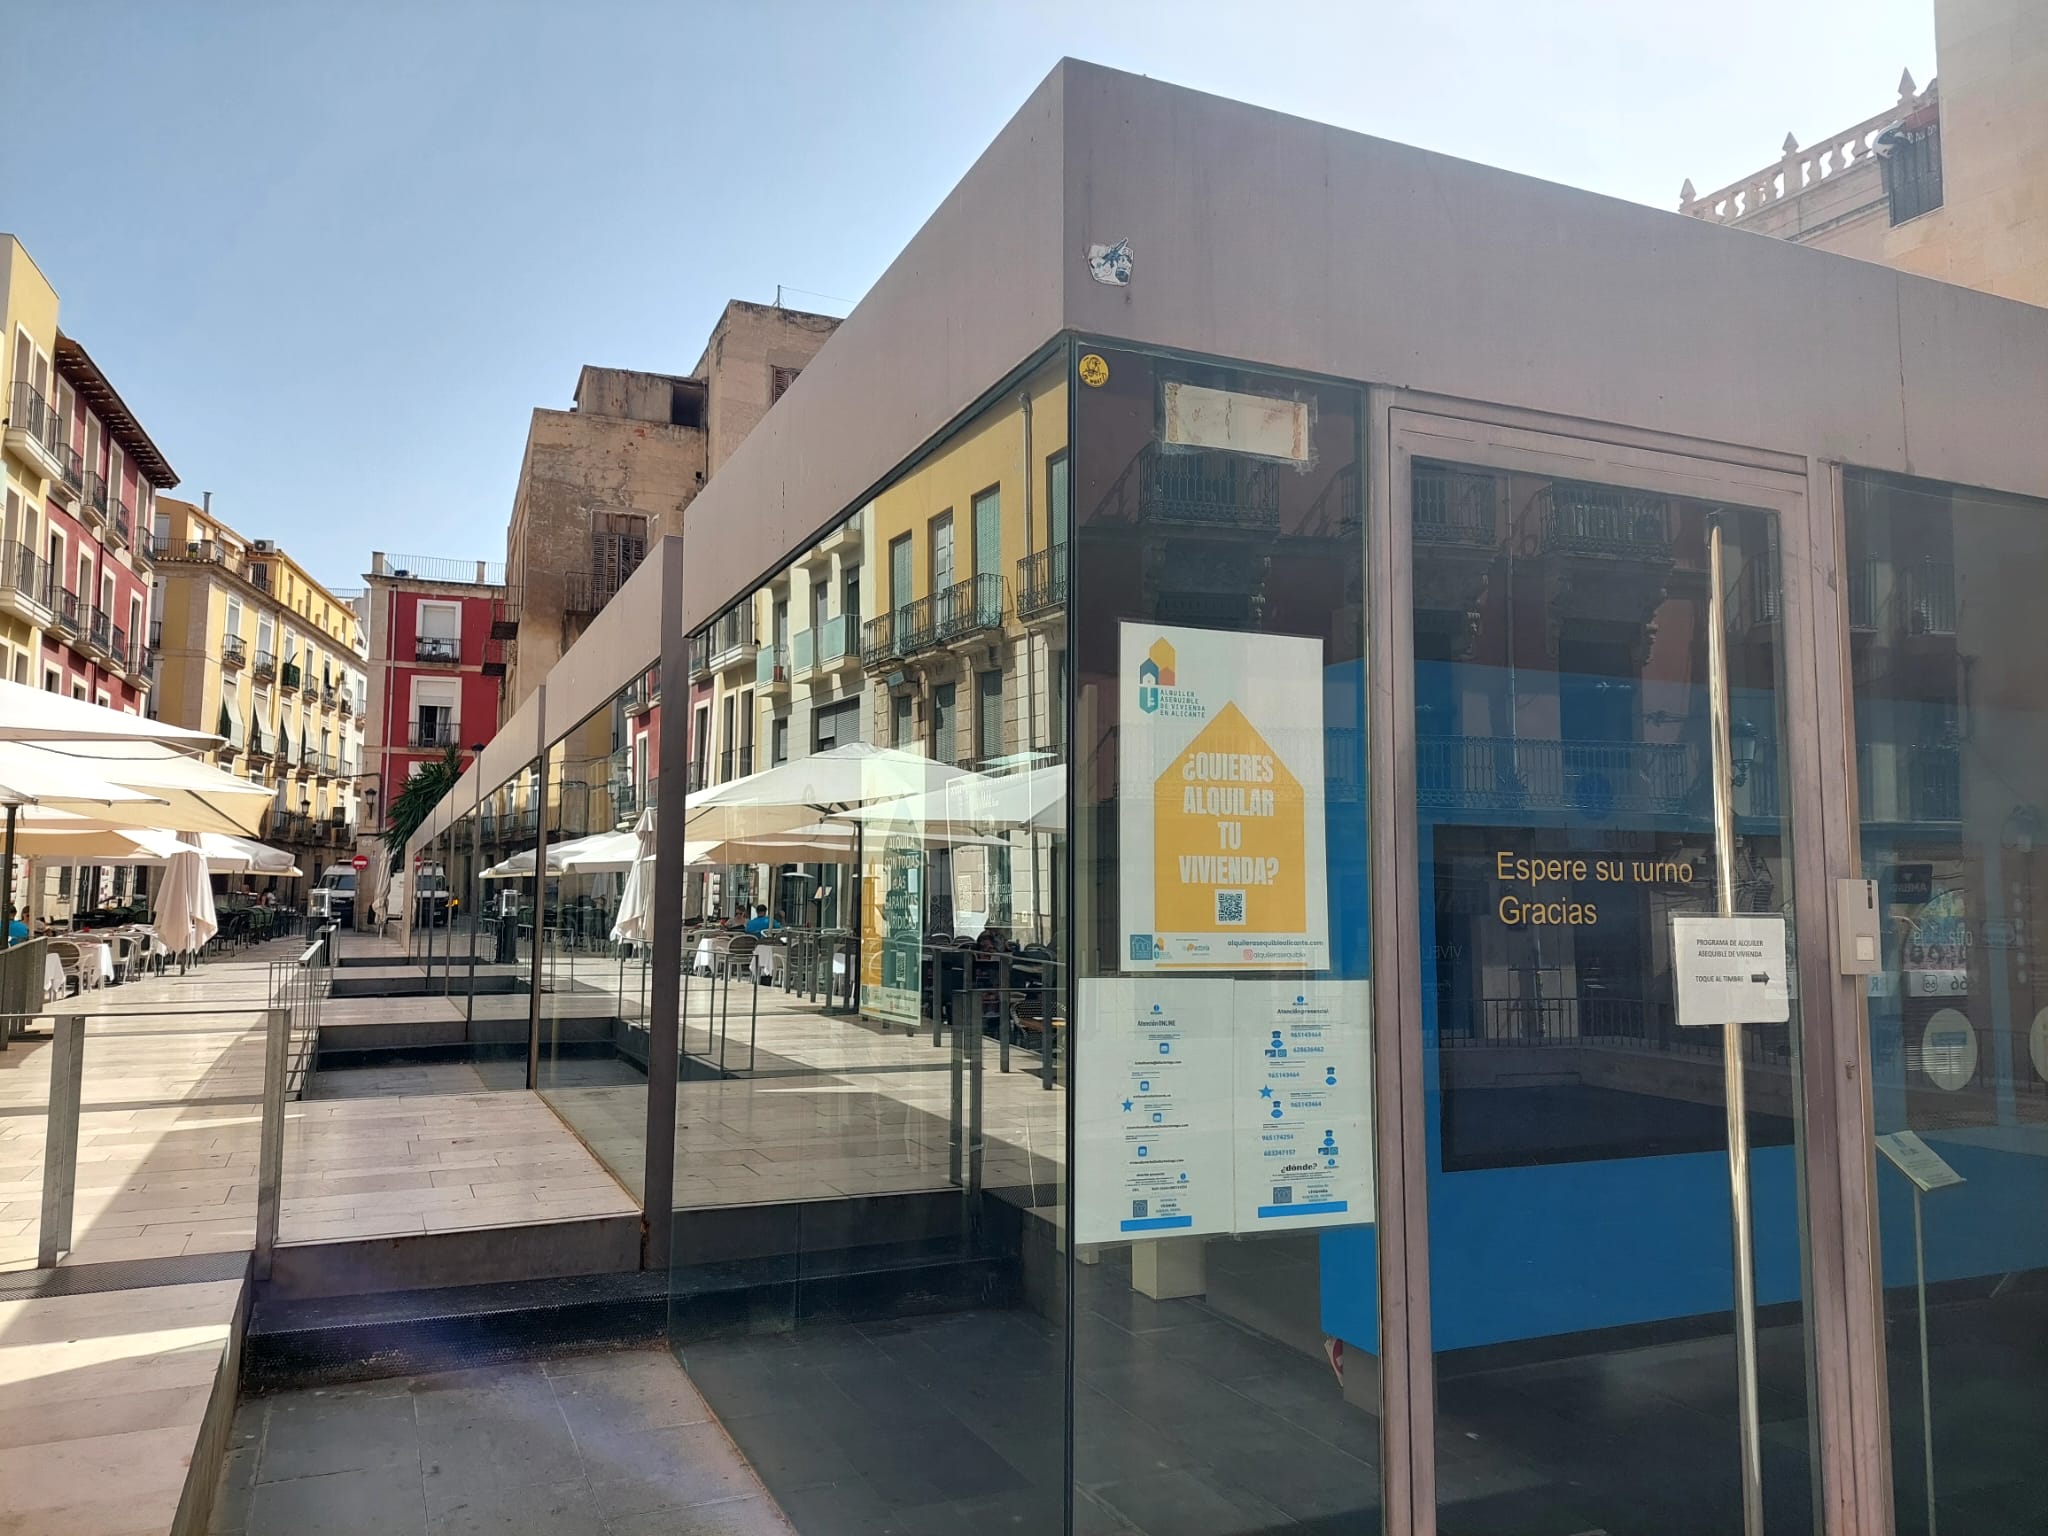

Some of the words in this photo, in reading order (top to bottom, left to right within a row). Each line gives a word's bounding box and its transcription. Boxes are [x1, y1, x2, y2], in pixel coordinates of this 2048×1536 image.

[1183, 752, 1274, 783] ¿QUIERES
[1183, 786, 1274, 816] ALQUILAR
[1217, 821, 1241, 850] TU
[1179, 855, 1279, 885] VIVIENDA?
[1497, 851, 1587, 887] Espere
[1596, 861, 1624, 882] su
[1499, 896, 1598, 925] Gracias
